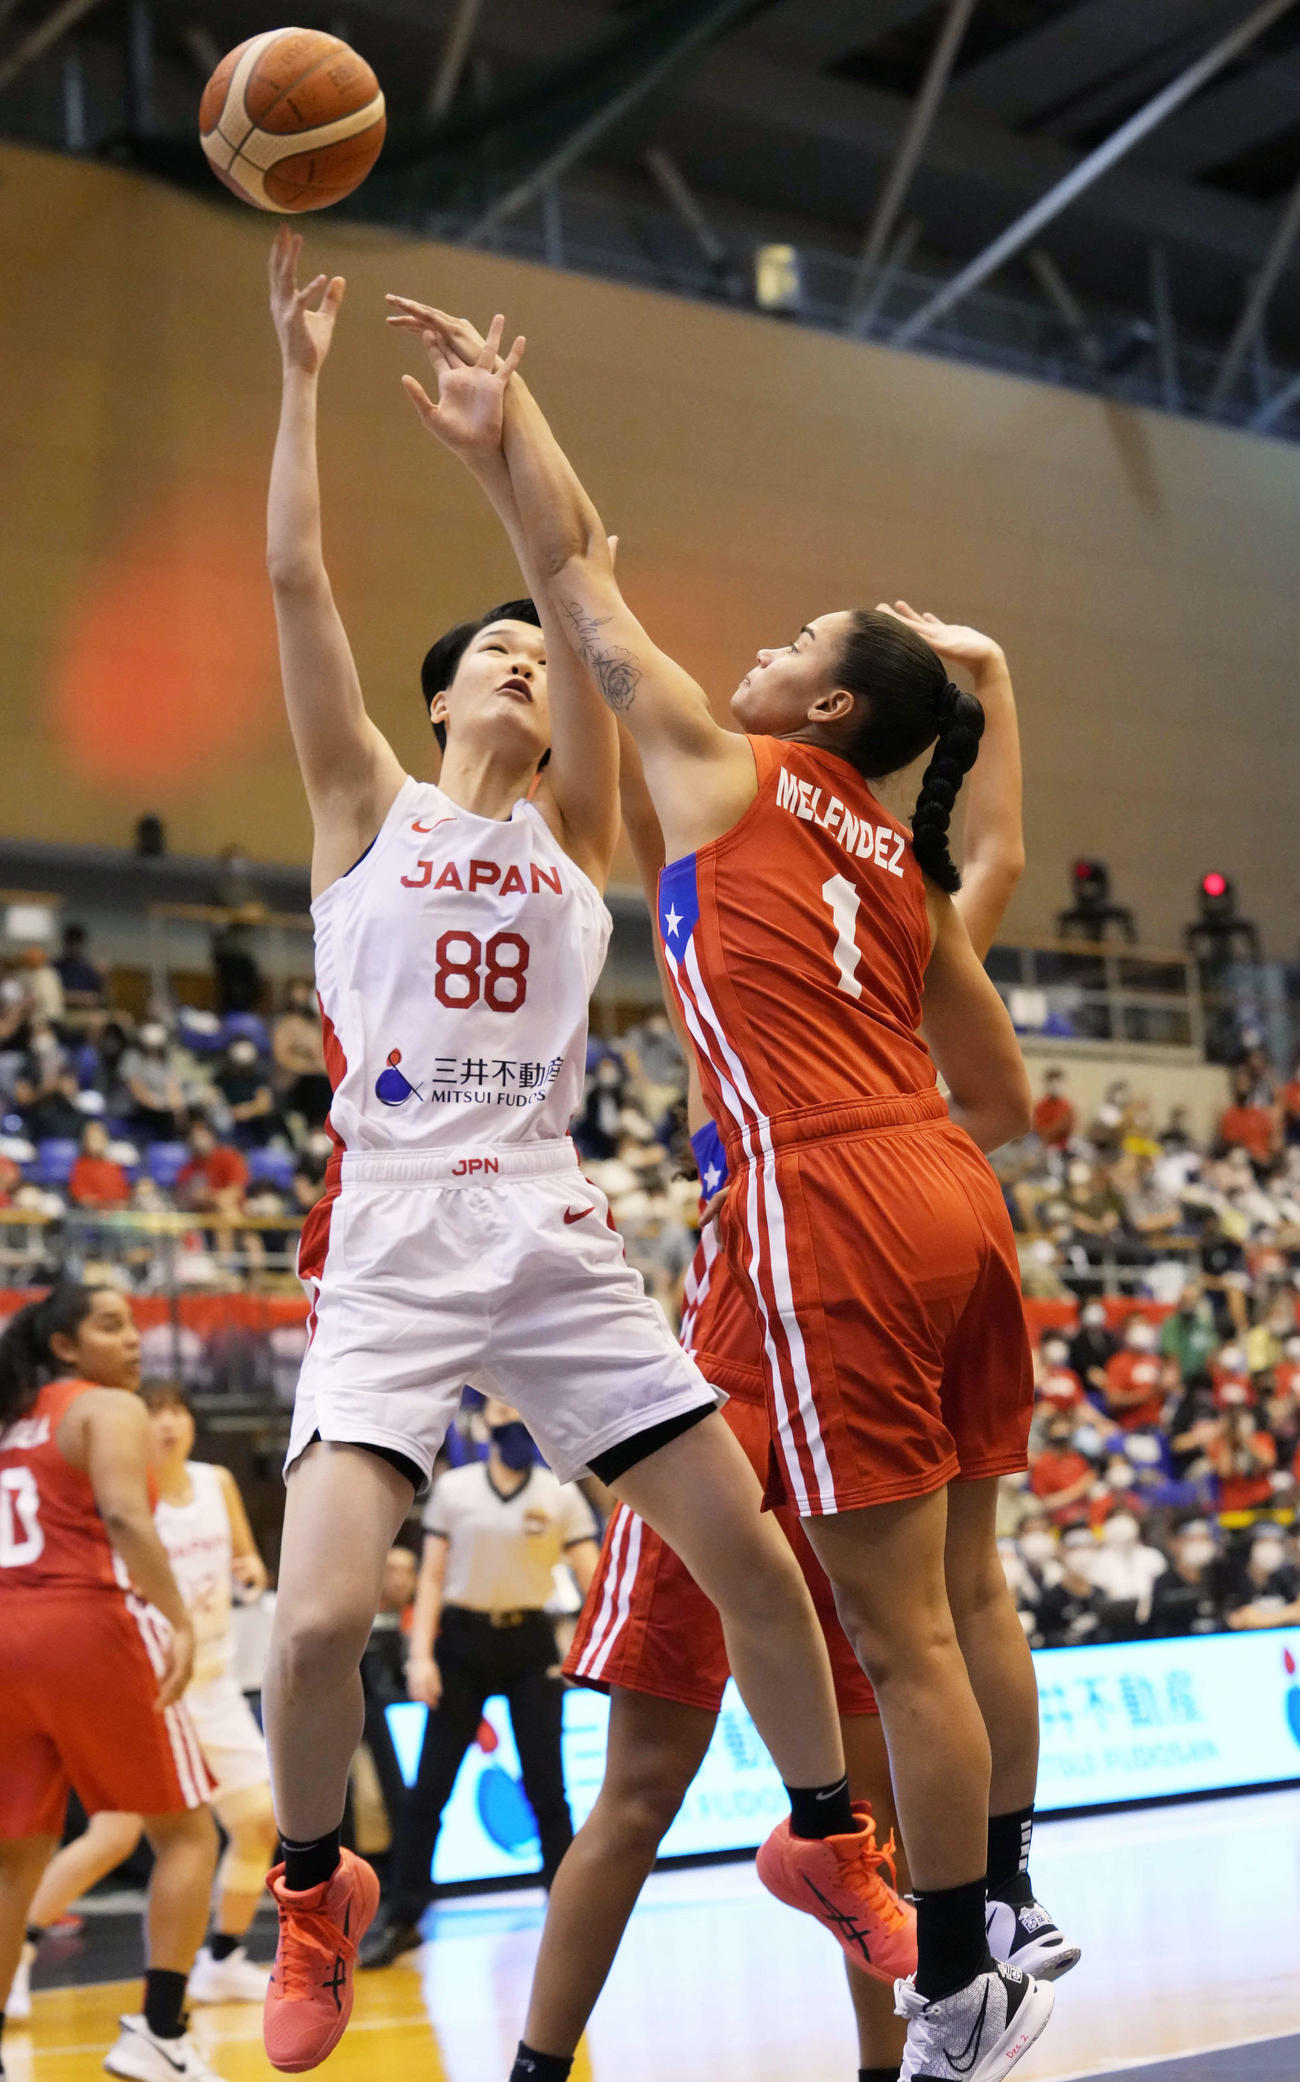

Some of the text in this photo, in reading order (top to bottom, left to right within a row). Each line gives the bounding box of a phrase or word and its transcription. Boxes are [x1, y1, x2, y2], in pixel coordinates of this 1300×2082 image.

[775, 765, 905, 878] MELENDEZ
[400, 859, 563, 896] JAPAN
[821, 872, 863, 1001] 1
[434, 929, 530, 1013] 88
[432, 1056, 564, 1088] 三井不動産
[431, 1090, 491, 1104] MITSUI
[451, 1156, 499, 1176] JPN
